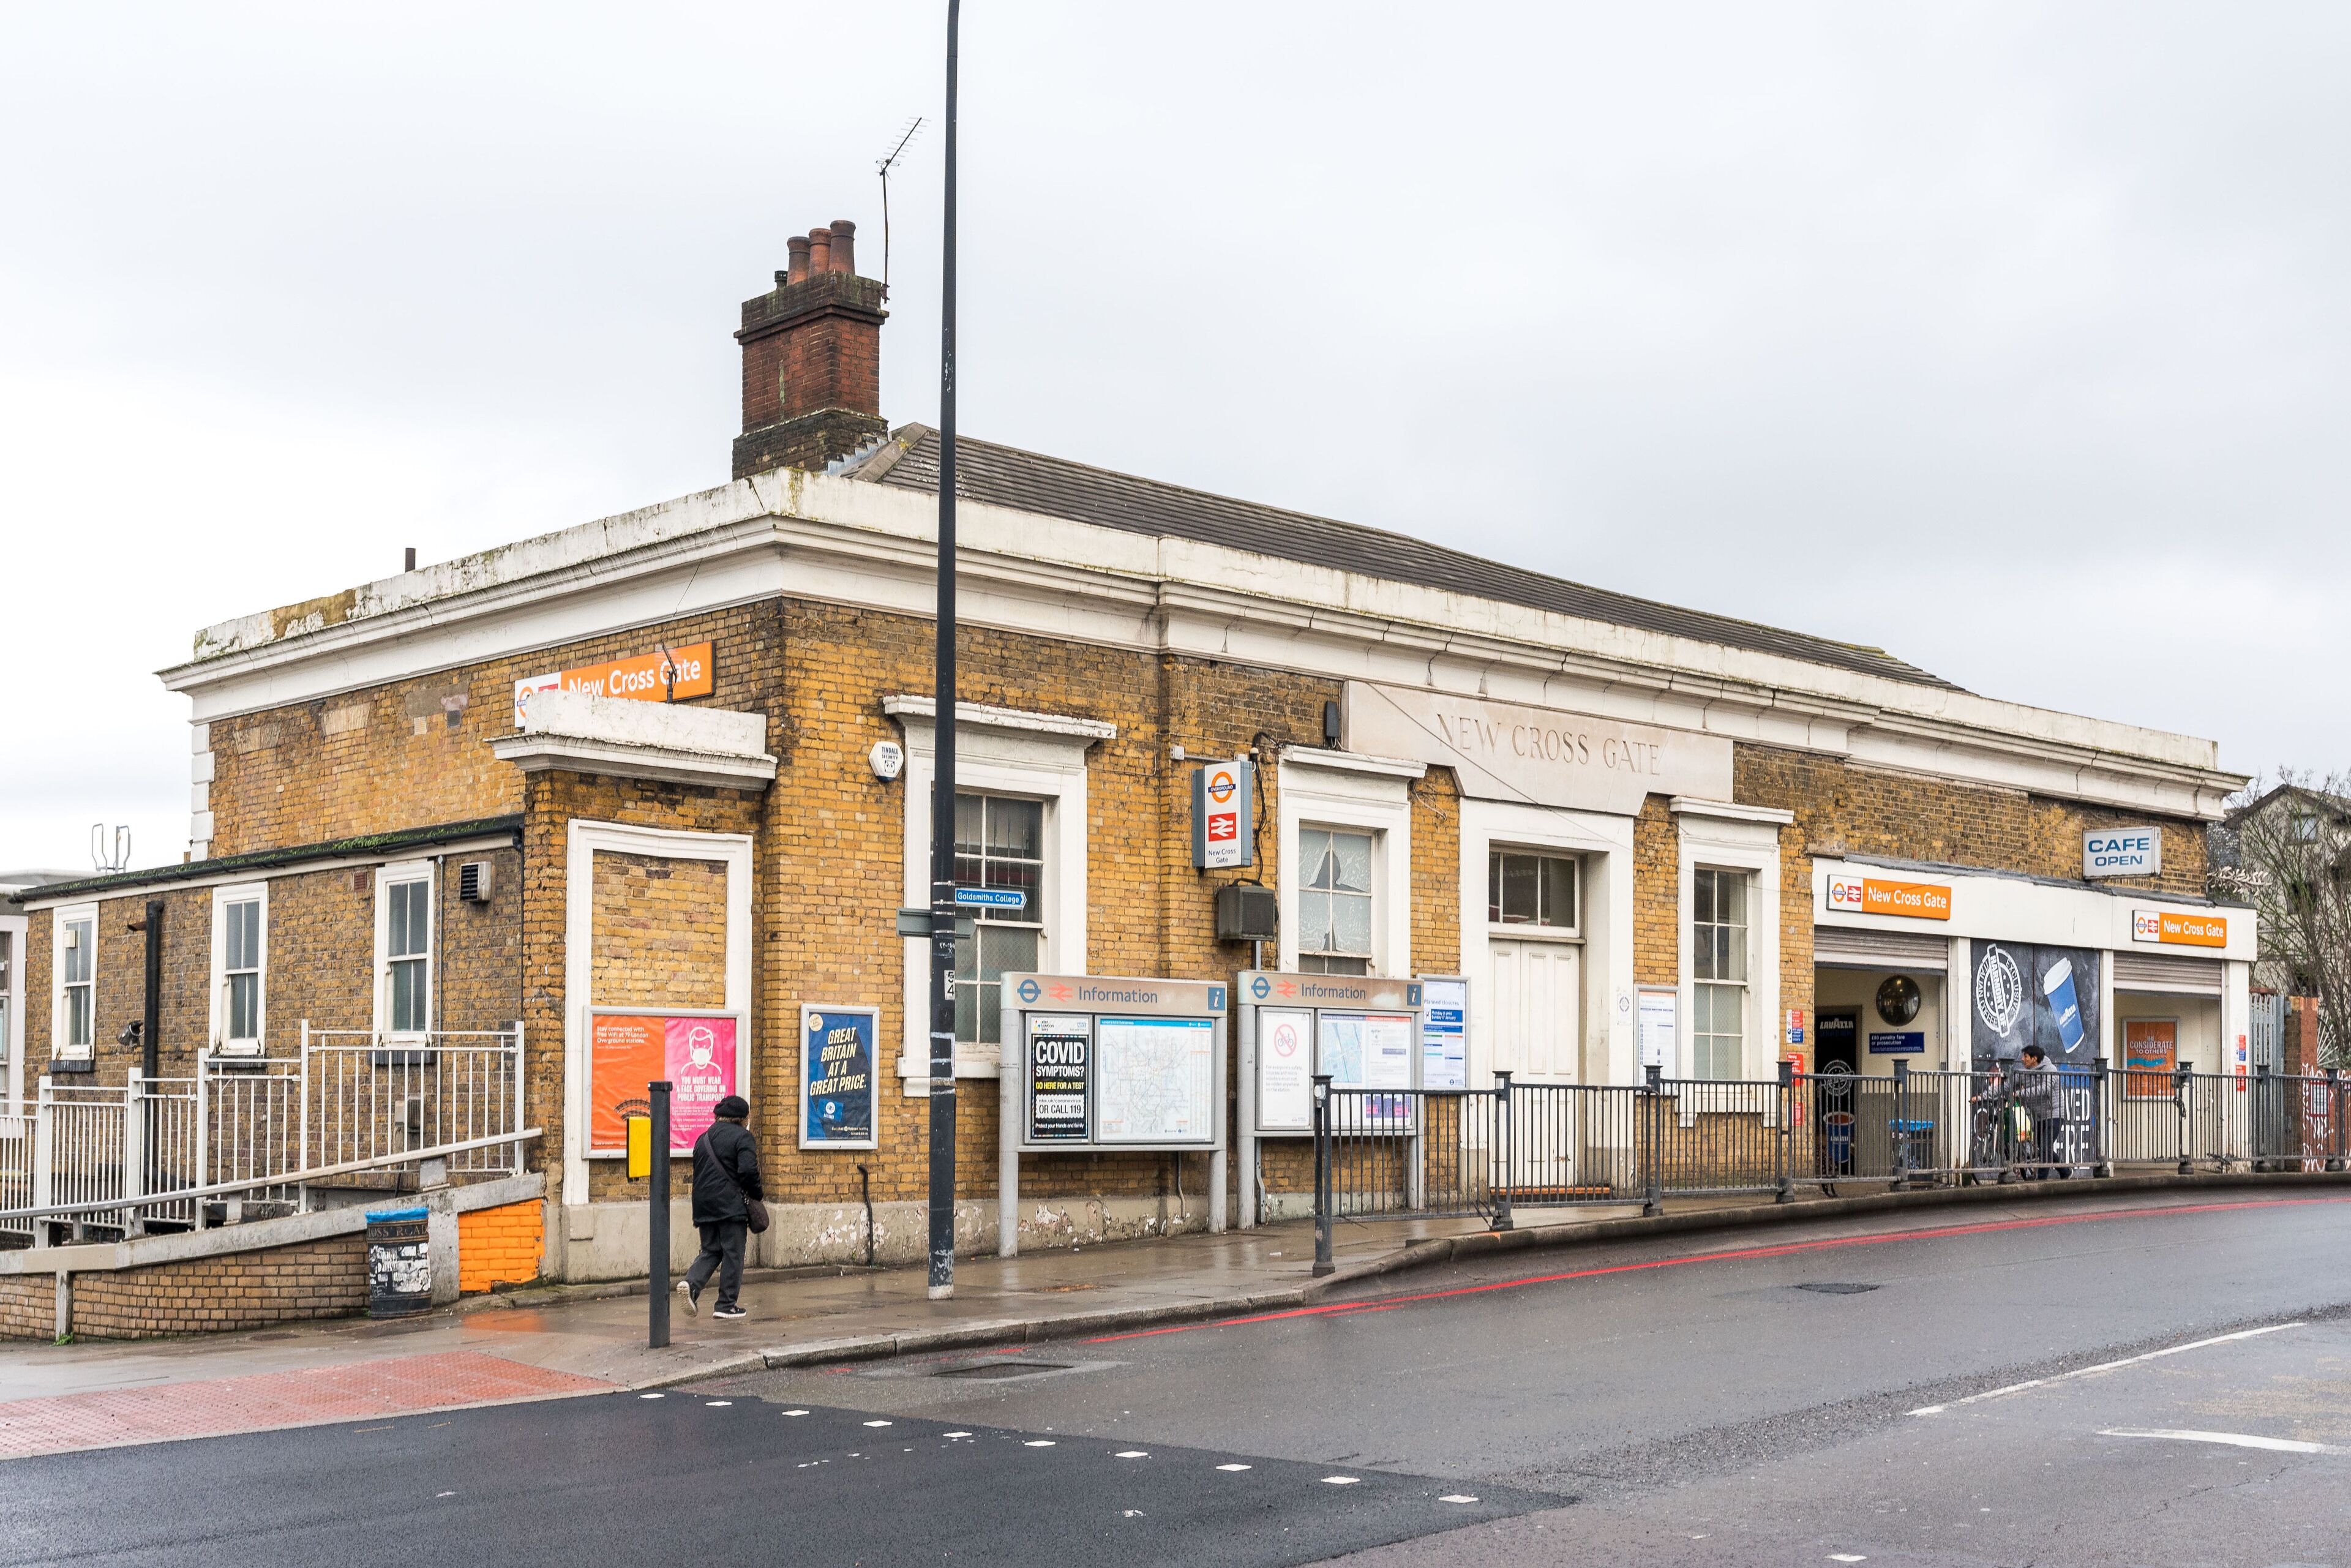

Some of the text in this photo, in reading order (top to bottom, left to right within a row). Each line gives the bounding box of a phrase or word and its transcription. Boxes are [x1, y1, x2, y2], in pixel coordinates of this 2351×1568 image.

[569, 659, 700, 696] New Cross Gate
[1437, 714, 1660, 776] NEW CROSS GATE
[2088, 838, 2150, 853] CAFE
[2094, 855, 2143, 867] OPEN
[958, 892, 1019, 904] Goldsmiths College
[1868, 887, 1946, 909] New Cross Gate
[2164, 920, 2224, 938] New Cross Gate
[1078, 986, 1158, 1003] Information
[1301, 983, 1367, 1000] Information
[1978, 960, 1998, 1027] ITALIAN COFFEE
[1990, 955, 2007, 1027] HARMONY OF
[2006, 959, 2019, 1015] EXCLUSIVE
[1820, 1018, 1854, 1029] LAVAZZA
[828, 1027, 856, 1045] GREAT
[2129, 1041, 2173, 1049] CONSIDERATE
[821, 1043, 857, 1062] BRITAIN
[1036, 1041, 1085, 1063] COVID
[828, 1060, 847, 1078] AT A
[1036, 1065, 1084, 1077] SYMPTOMS?
[810, 1073, 866, 1097] GREAT PRICE.
[677, 1093, 694, 1101] PUBLIC
[1039, 1105, 1081, 1114] OR CALL 119
